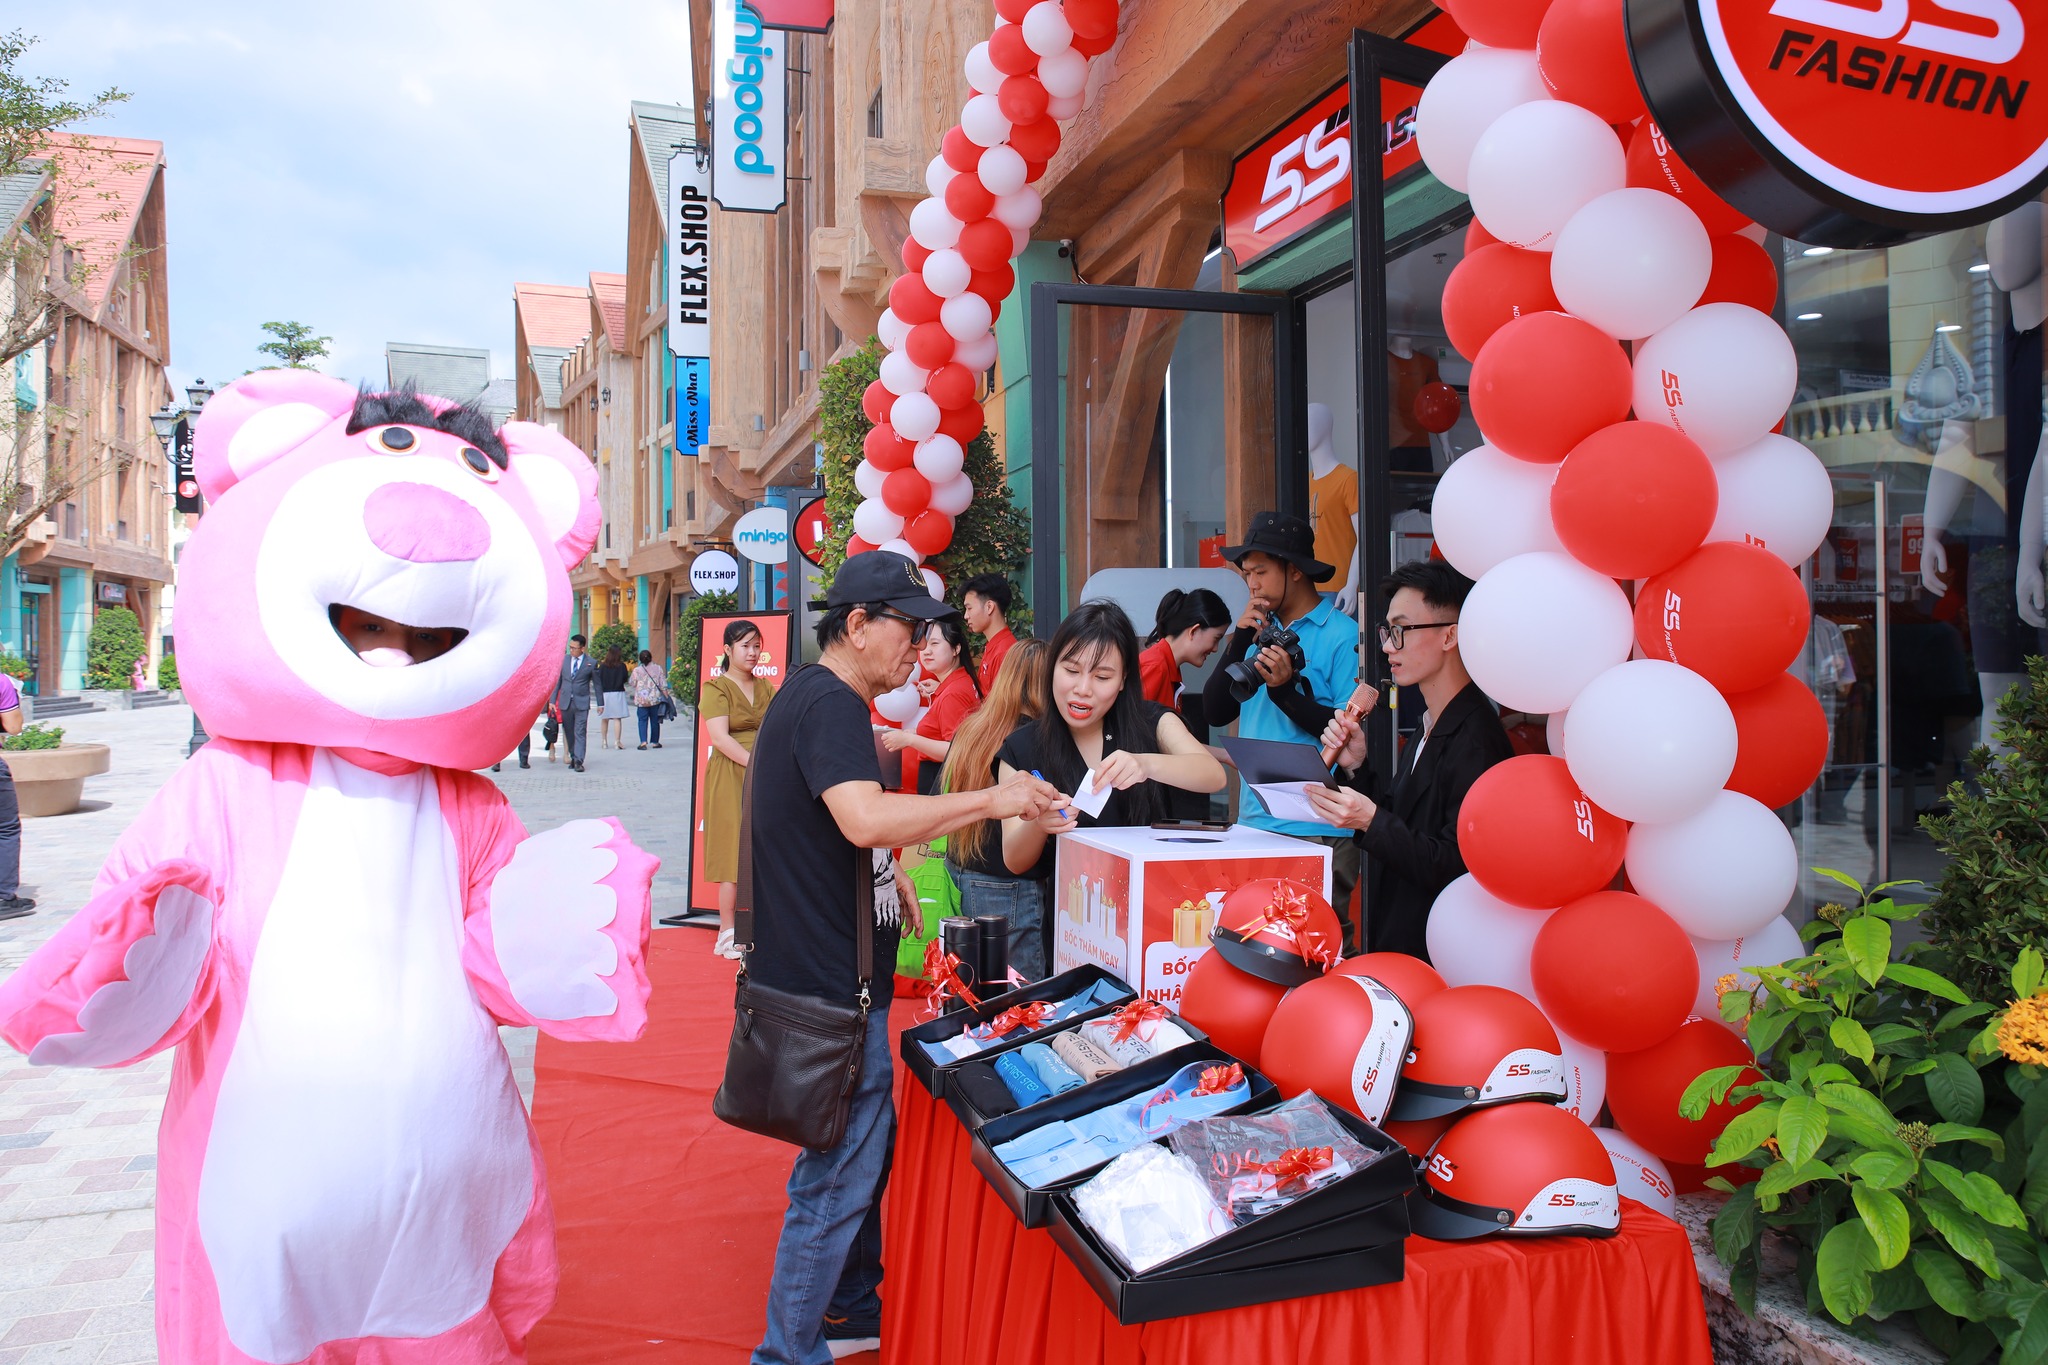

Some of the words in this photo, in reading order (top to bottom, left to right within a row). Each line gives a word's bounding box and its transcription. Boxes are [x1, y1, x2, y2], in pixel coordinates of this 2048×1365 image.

[726, 0, 774, 174] nigood
[1767, 29, 2030, 119] FASHION
[1253, 103, 1351, 233] 5S
[1658, 158, 1683, 194] FASHION
[680, 185, 708, 325] FLEX.SHOP
[686, 371, 698, 407] Nha
[1661, 368, 1684, 408] 5S
[686, 410, 698, 448] Miss
[1667, 407, 1687, 436] FASHIO
[694, 570, 736, 580] FLEX.SHOP
[1663, 588, 1681, 631] 5S
[1573, 799, 1594, 843] 5S
[1064, 928, 1077, 948] BỐC
[1099, 948, 1119, 970] NGAY
[1146, 983, 1182, 1005] NHẬ
[1019, 1076, 1040, 1092] STEP
[1361, 1066, 1379, 1096] 5S
[1375, 1041, 1386, 1070] FASHION
[1506, 1064, 1530, 1077] 5S
[1428, 1153, 1458, 1182] 5S
[1607, 1150, 1642, 1168] FASHIO
[1640, 1166, 1673, 1199] 5S
[1547, 1194, 1576, 1207] 5S
